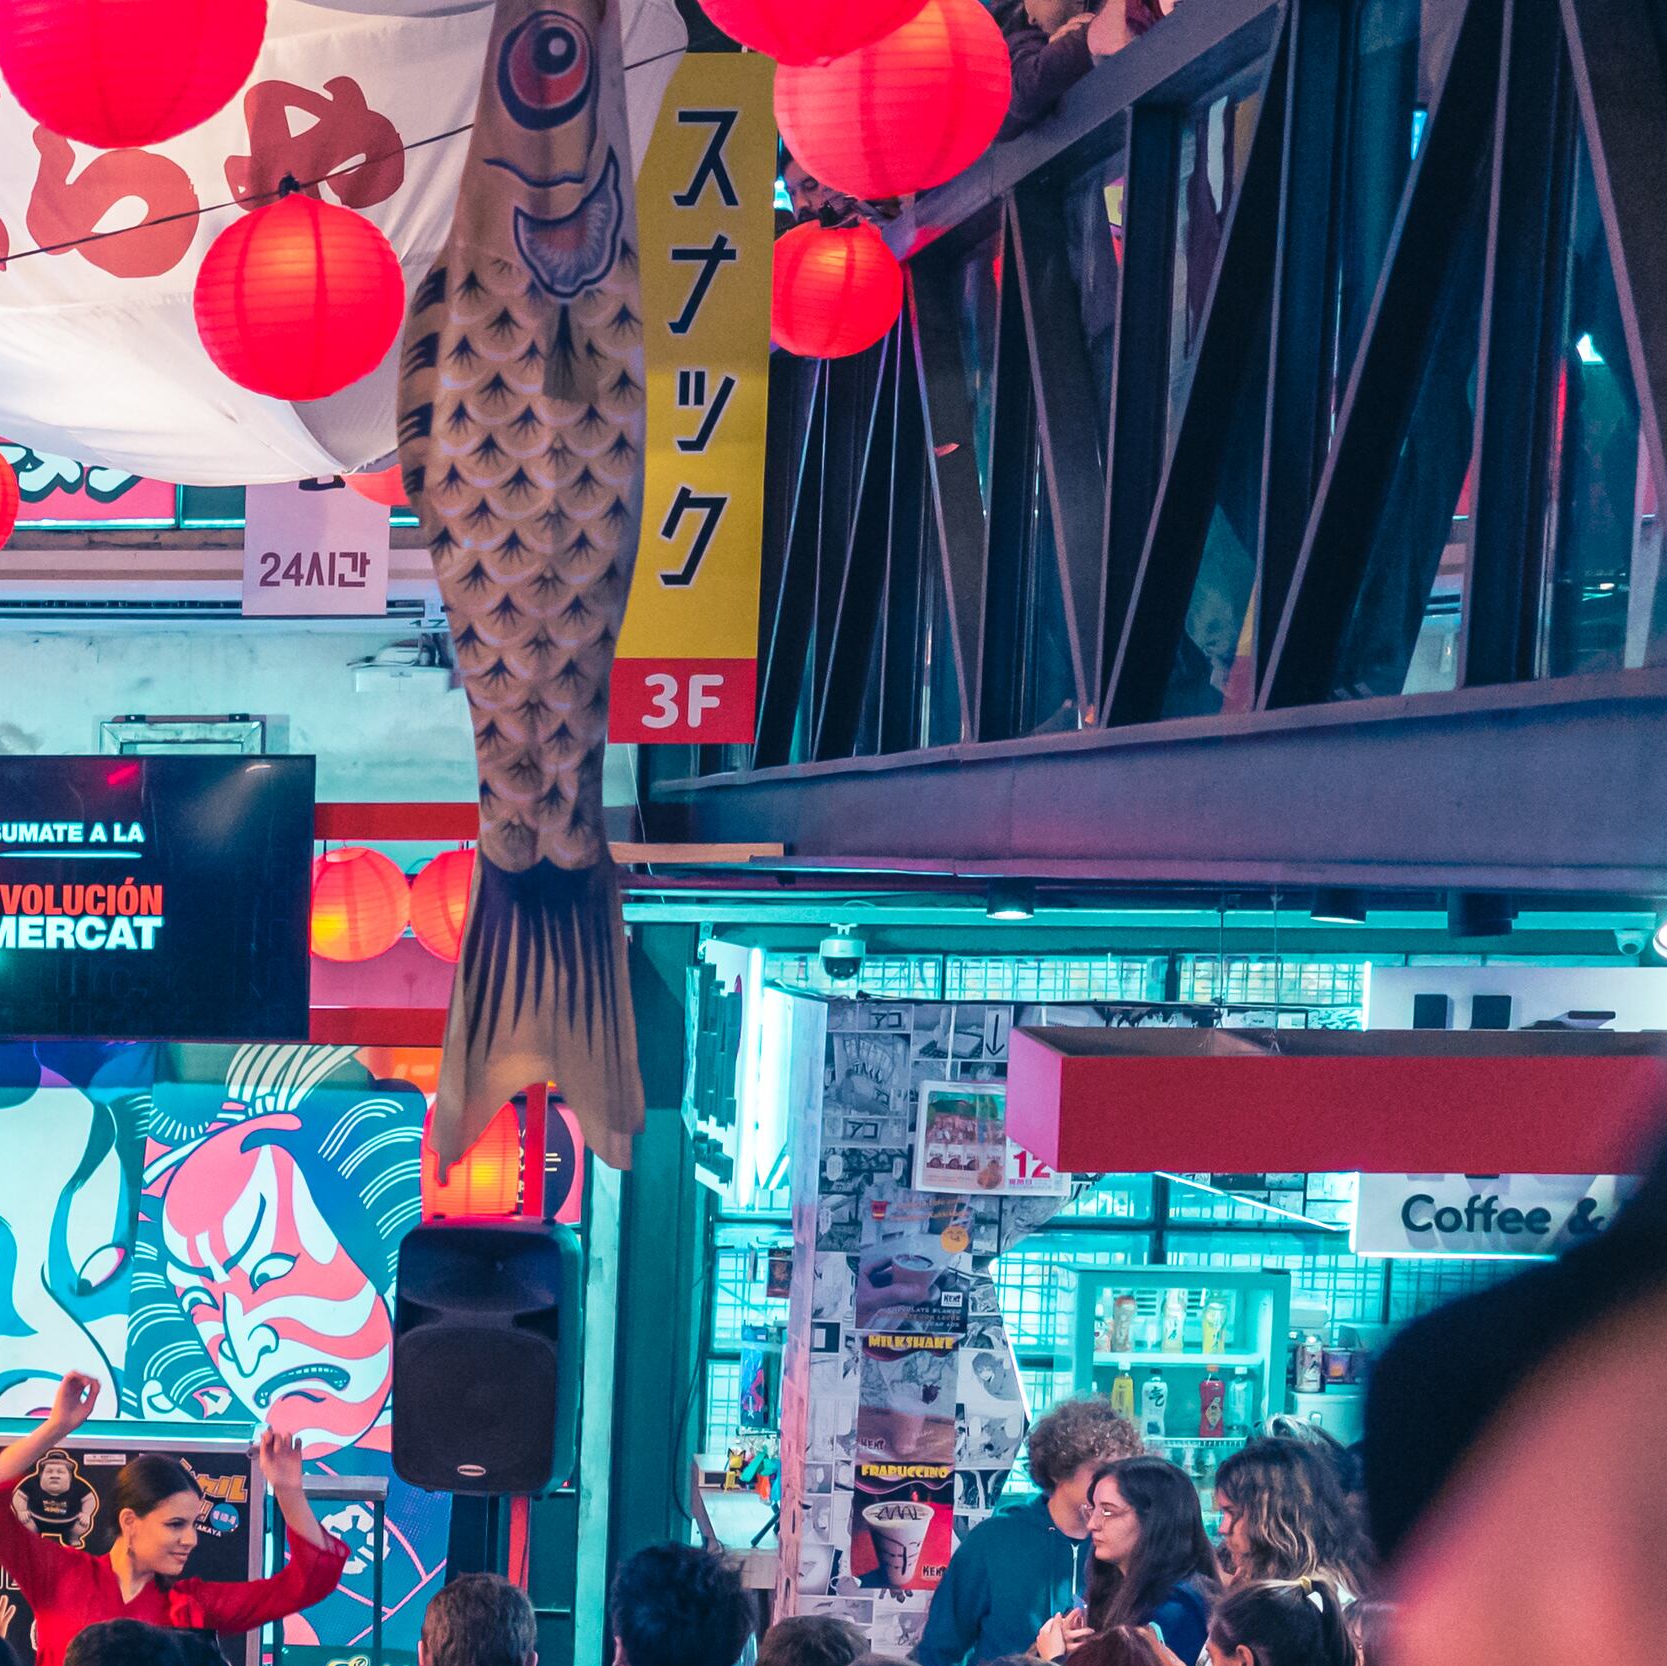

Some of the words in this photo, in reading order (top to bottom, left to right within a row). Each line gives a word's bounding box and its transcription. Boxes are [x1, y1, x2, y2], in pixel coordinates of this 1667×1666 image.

[659, 107, 742, 590] スナック
[260, 551, 370, 588] 24시간
[640, 673, 725, 730] 3F
[89, 822, 109, 844] A
[113, 823, 145, 844] LA
[1401, 1193, 1552, 1235] Coffee
[868, 1334, 955, 1350] MILKSHAKE
